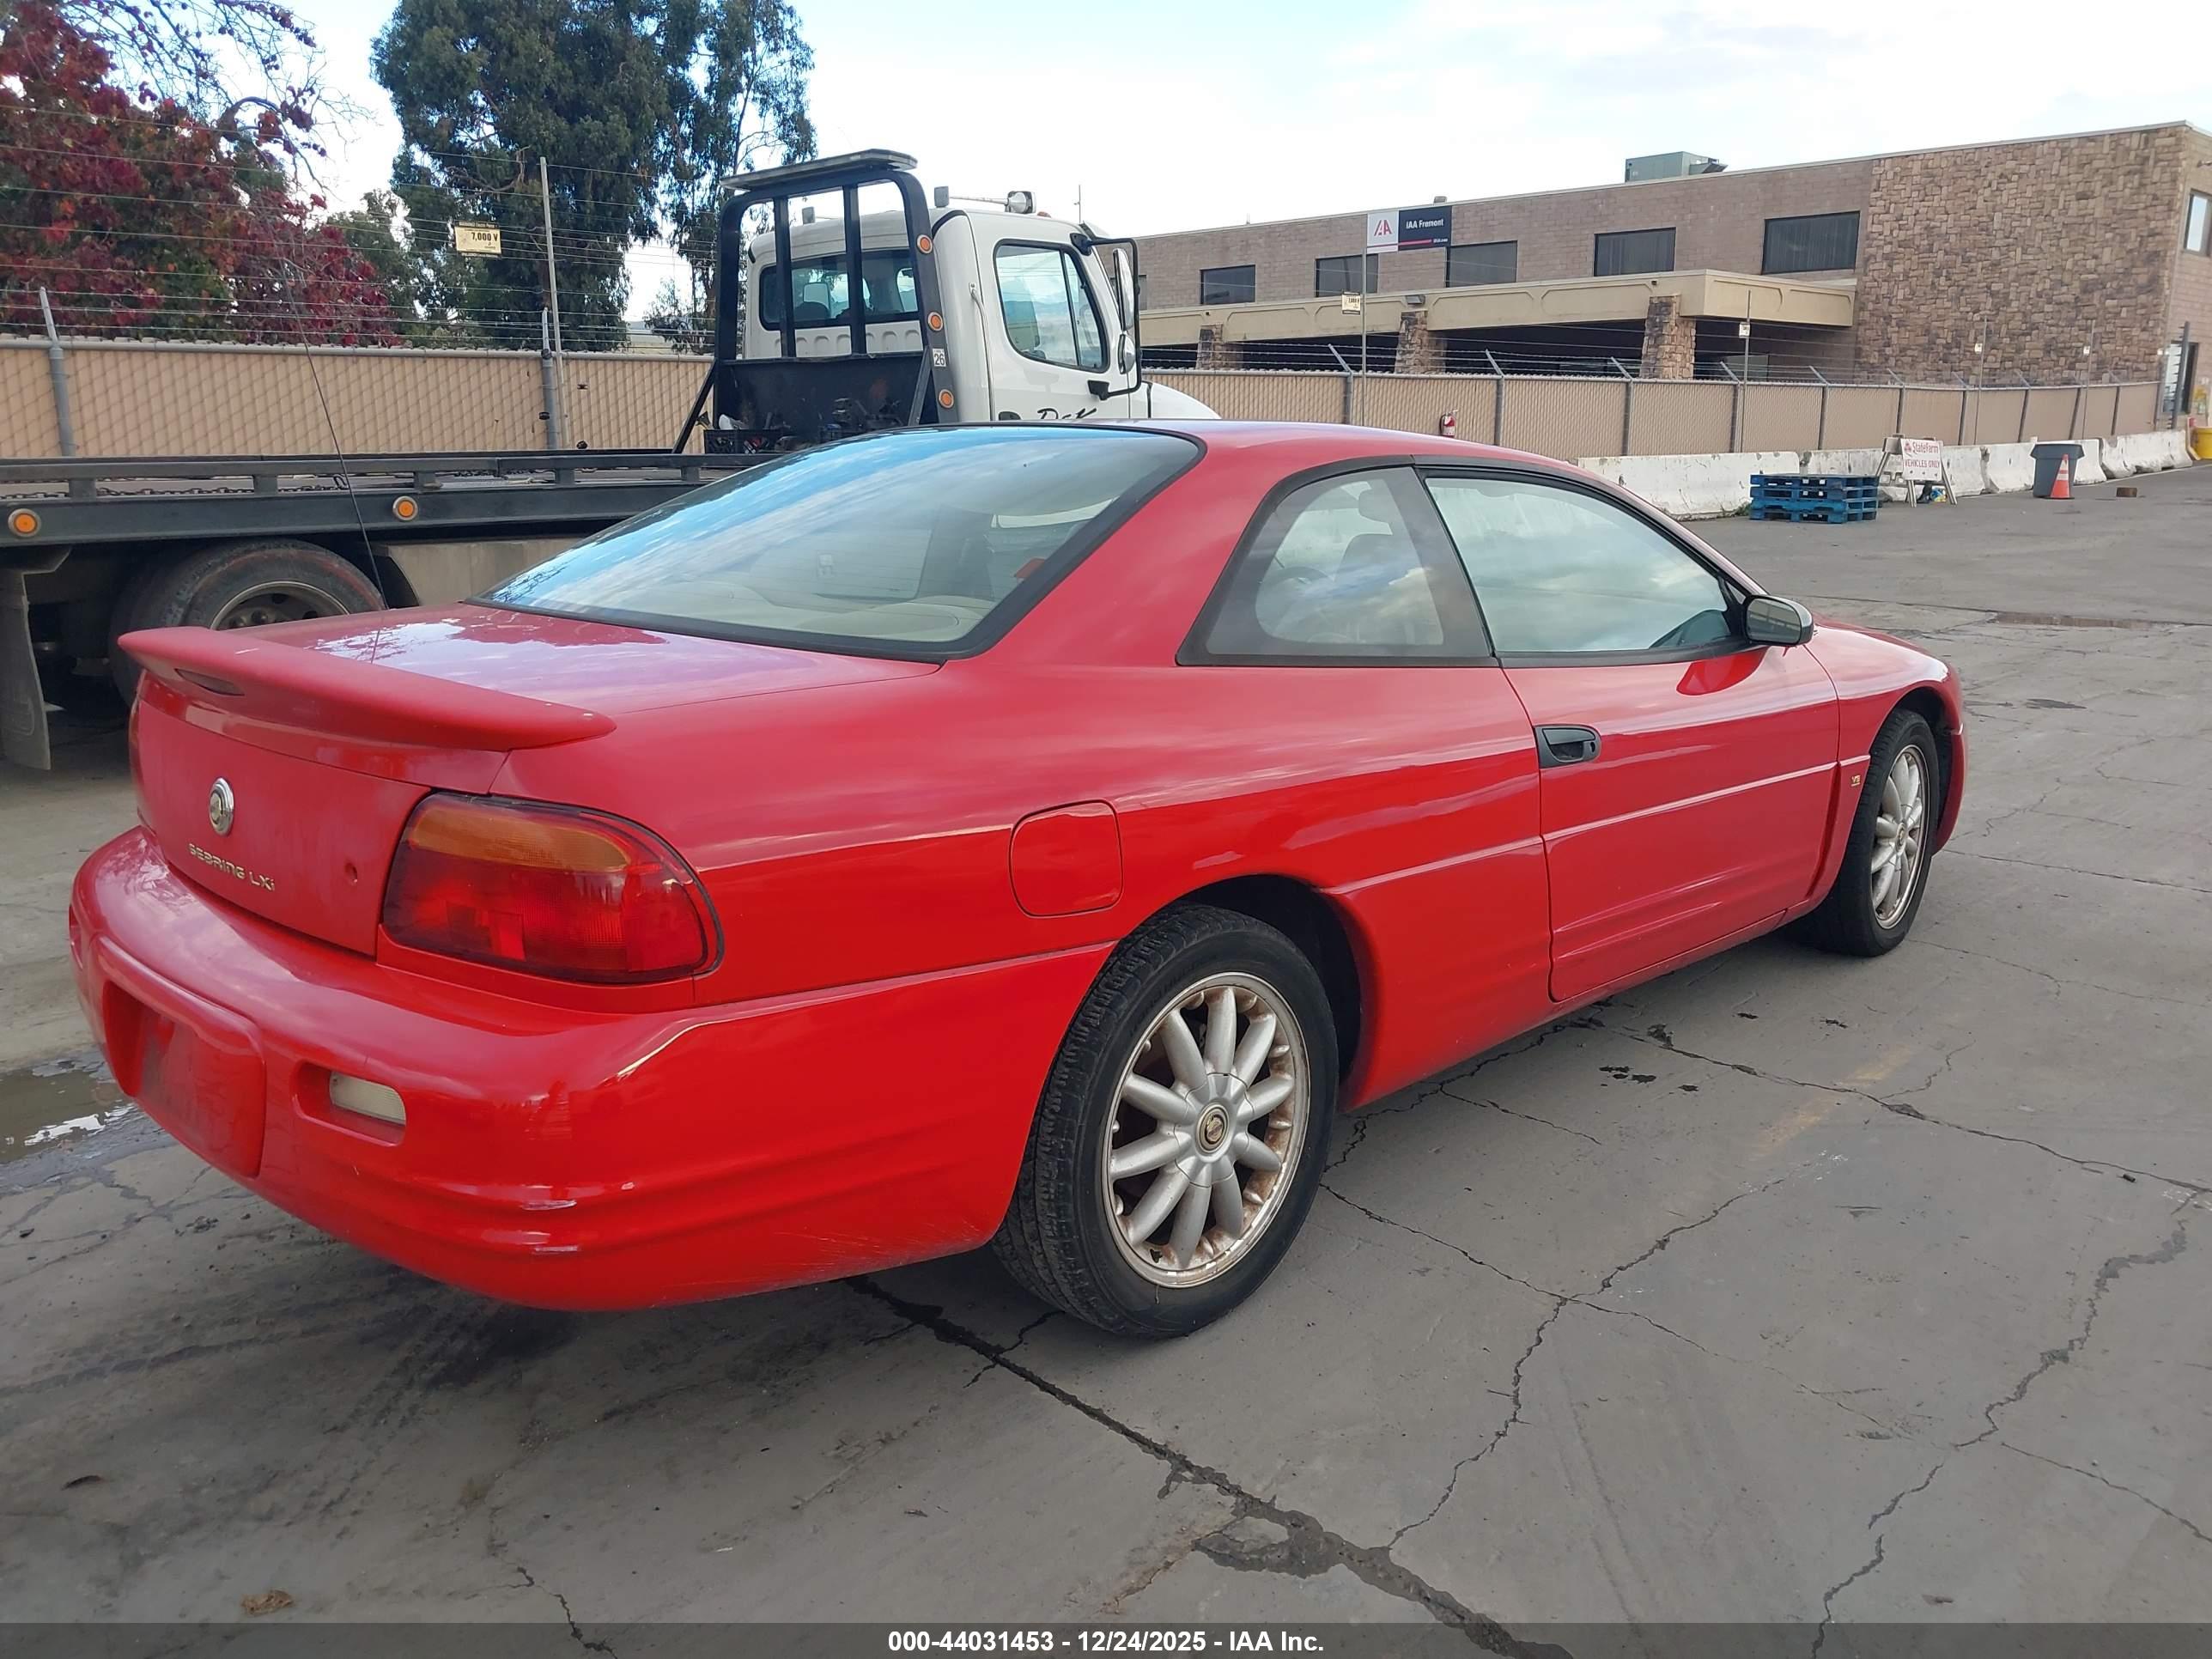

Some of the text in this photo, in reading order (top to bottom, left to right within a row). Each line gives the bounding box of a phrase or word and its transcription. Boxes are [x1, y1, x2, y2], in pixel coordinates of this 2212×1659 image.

[1406, 218, 1444, 229] IAA Fremont
[471, 232, 498, 242] 7,000 V
[934, 353, 945, 365] 26
[1904, 459, 1928, 468] VEHICLES
[188, 842, 276, 891] SEBRING LXi
